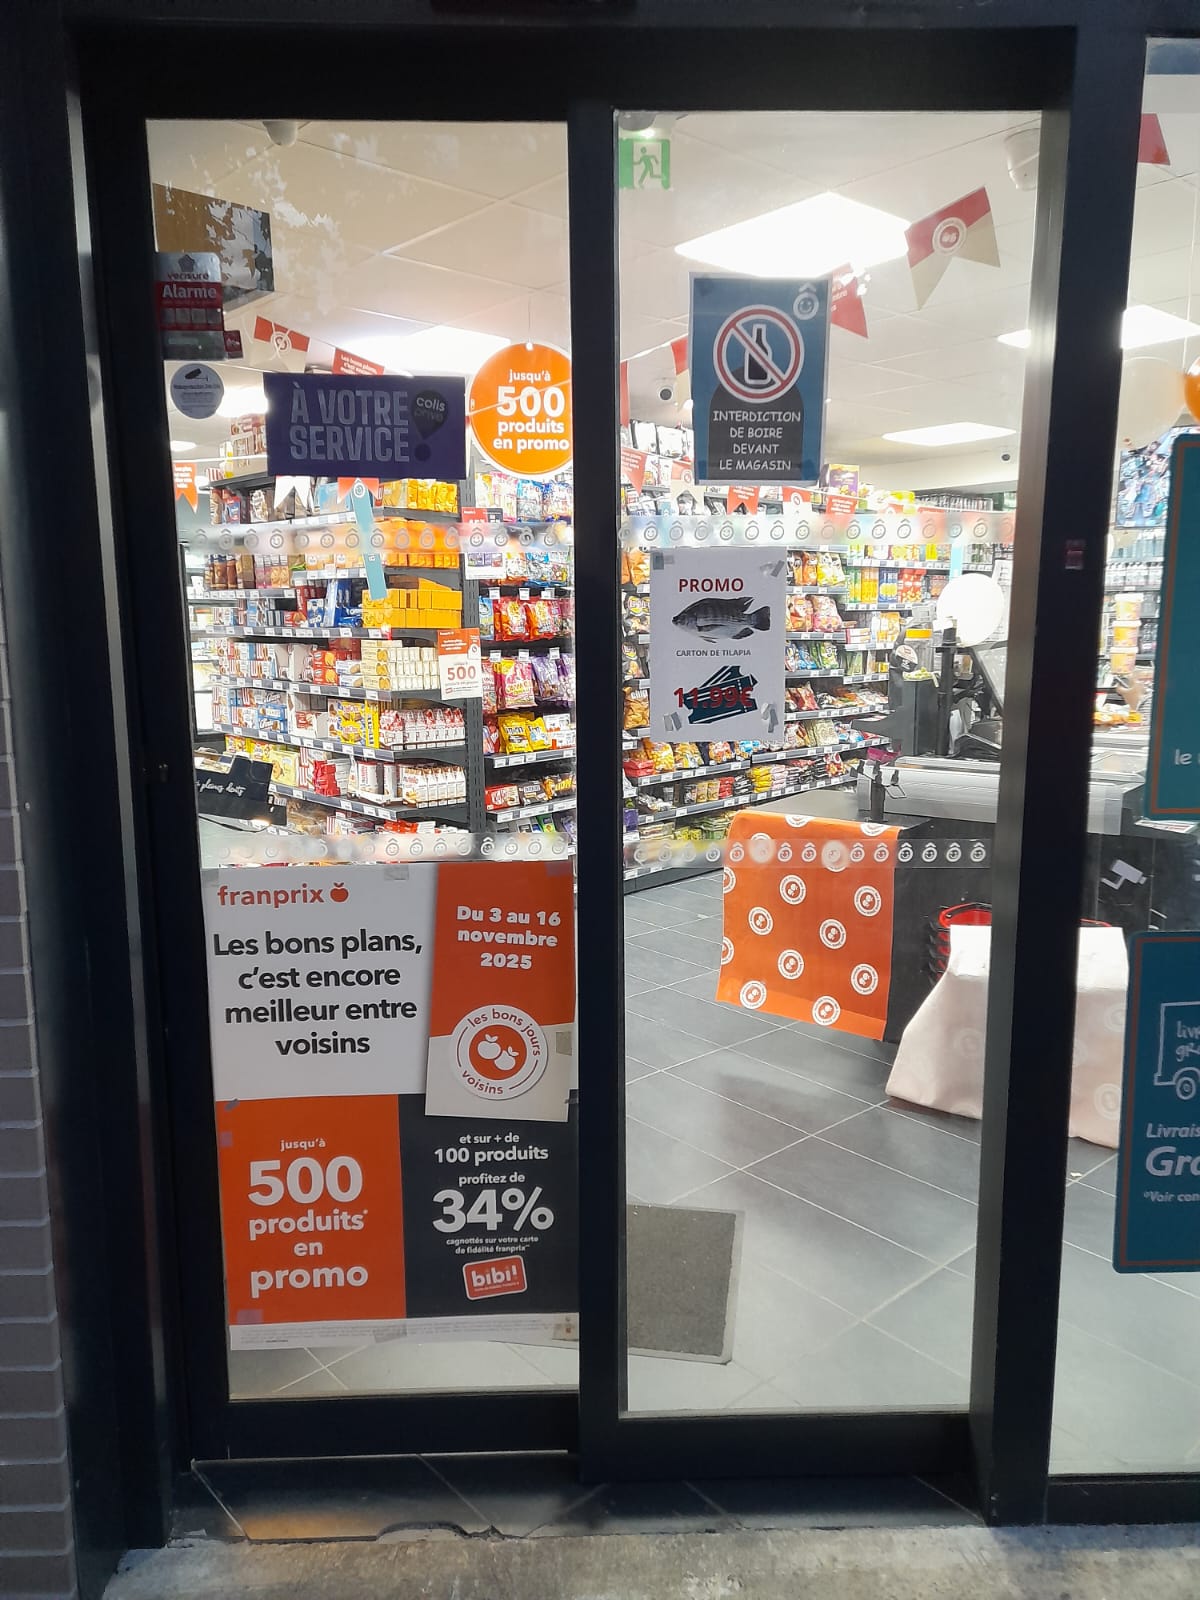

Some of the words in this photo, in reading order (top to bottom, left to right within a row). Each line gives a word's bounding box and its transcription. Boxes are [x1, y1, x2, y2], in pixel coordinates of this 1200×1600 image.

[162, 284, 216, 298] Alarme
[509, 369, 552, 384] jusqu'à
[290, 382, 310, 424] À
[317, 389, 409, 426] VOTRE
[416, 396, 446, 412] colis
[496, 386, 565, 418] 500
[712, 410, 801, 422] INTERDICTION
[498, 418, 564, 436] produits
[730, 427, 744, 438] DE
[748, 427, 783, 438] BOIRE
[290, 425, 410, 462] SERVICE
[493, 438, 513, 449] en
[517, 438, 570, 454] promo
[733, 444, 780, 455] DEVANT
[720, 459, 732, 470] LE
[736, 459, 791, 471] MAGASIN
[678, 578, 744, 592] PROMO
[448, 666, 476, 680] 500
[674, 686, 754, 708] 11.99€
[1174, 749, 1192, 765] le
[217, 883, 324, 908] franprix
[456, 906, 484, 922] Du
[489, 907, 502, 922] 3
[507, 912, 530, 924] au
[537, 911, 561, 926] 16
[214, 934, 259, 956] Les
[265, 931, 334, 954] bons
[341, 928, 422, 959] plans,
[458, 930, 558, 948] novembre
[480, 952, 532, 970] 2025
[238, 967, 300, 990] c'est
[306, 968, 400, 987] encore
[225, 998, 340, 1024] meilleur
[346, 999, 417, 1020] entre
[468, 1012, 488, 1028] les
[492, 1008, 523, 1026] bons
[520, 1022, 541, 1056] jours
[275, 1030, 370, 1056] voisins
[462, 1070, 504, 1095] voisins
[280, 1138, 326, 1152] jusqu'à
[459, 1134, 472, 1144] et
[474, 1134, 492, 1144] sur
[494, 1134, 502, 1142] +
[504, 1132, 520, 1143] de
[434, 1148, 470, 1163] 100
[474, 1146, 549, 1166] produits
[248, 1156, 363, 1206] 500
[458, 1172, 507, 1187] profitez
[509, 1172, 525, 1183] de
[432, 1186, 554, 1233] 34%
[294, 1241, 323, 1256] en
[446, 1237, 484, 1246] cagnottés
[466, 1245, 494, 1254] fidélité
[250, 1266, 368, 1298] promo
[472, 1264, 518, 1288] bibi!
